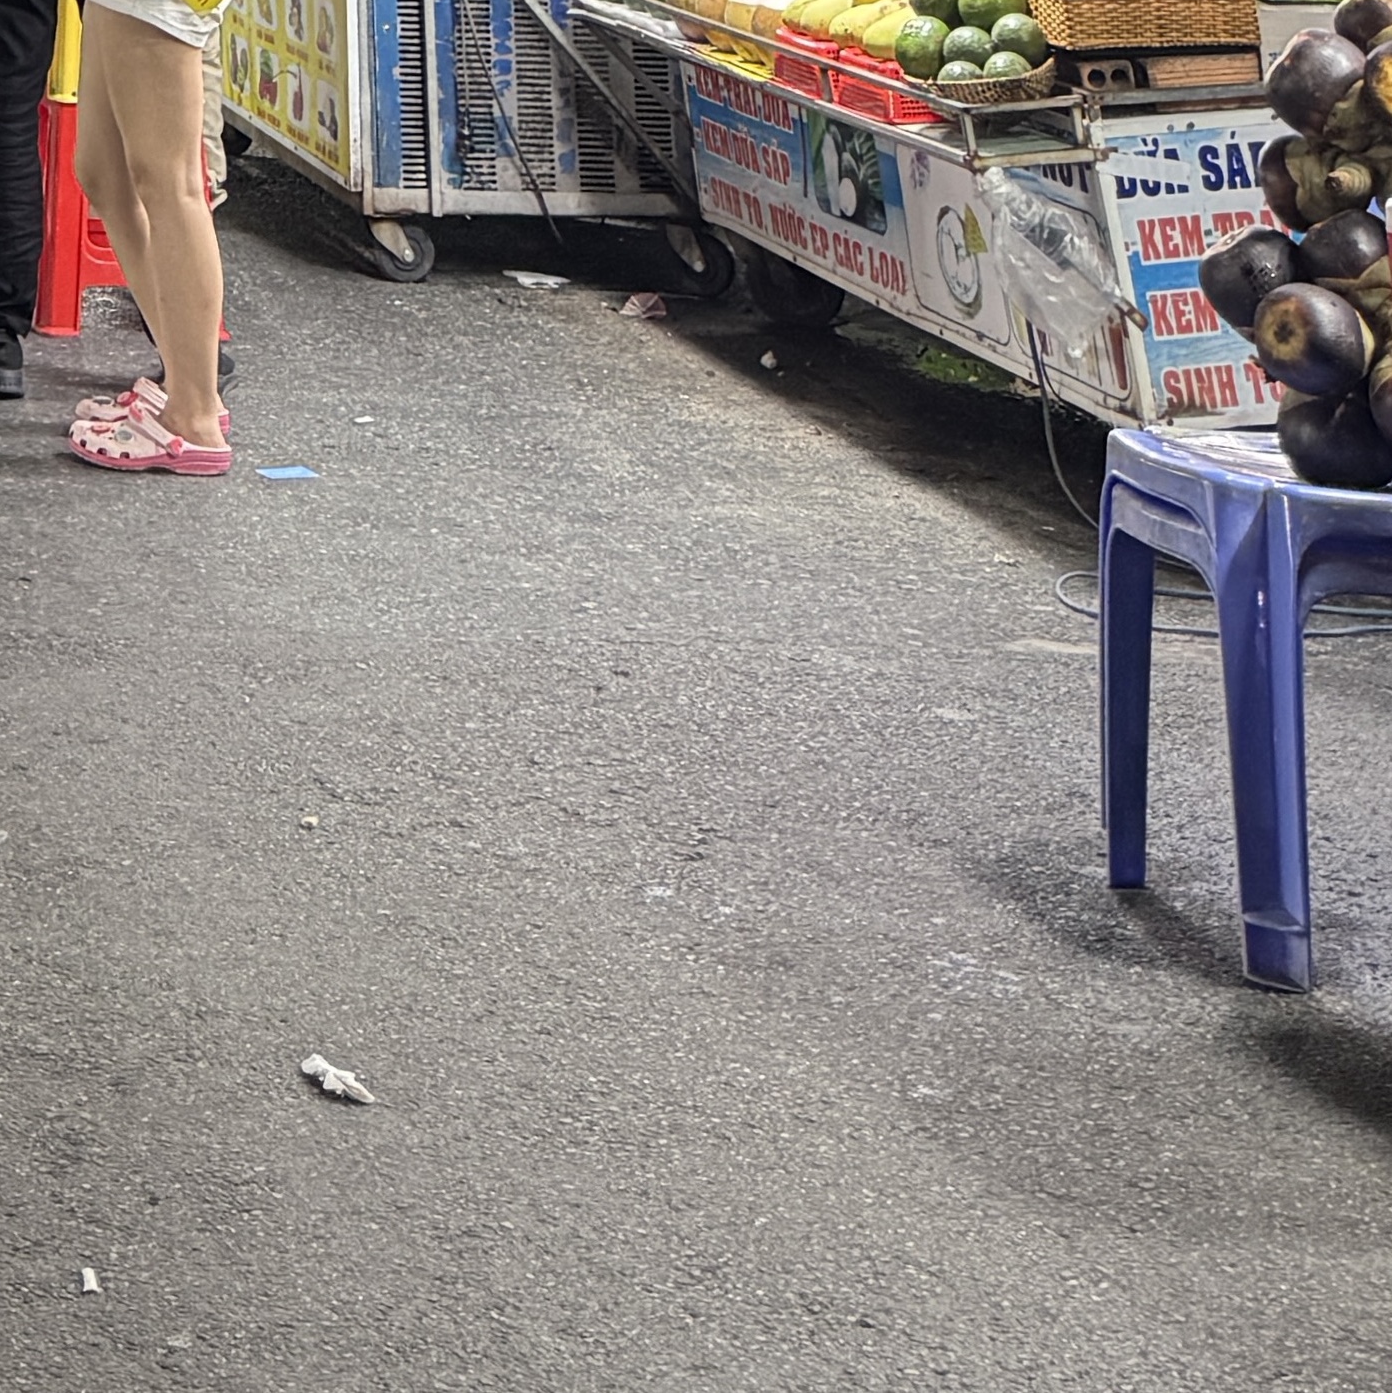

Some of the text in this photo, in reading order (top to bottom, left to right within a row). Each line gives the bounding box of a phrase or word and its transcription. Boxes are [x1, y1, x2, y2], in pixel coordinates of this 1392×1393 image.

[1136, 214, 1206, 262] KEM
[1148, 291, 1220, 337] KEM
[1163, 364, 1240, 412] SINH
